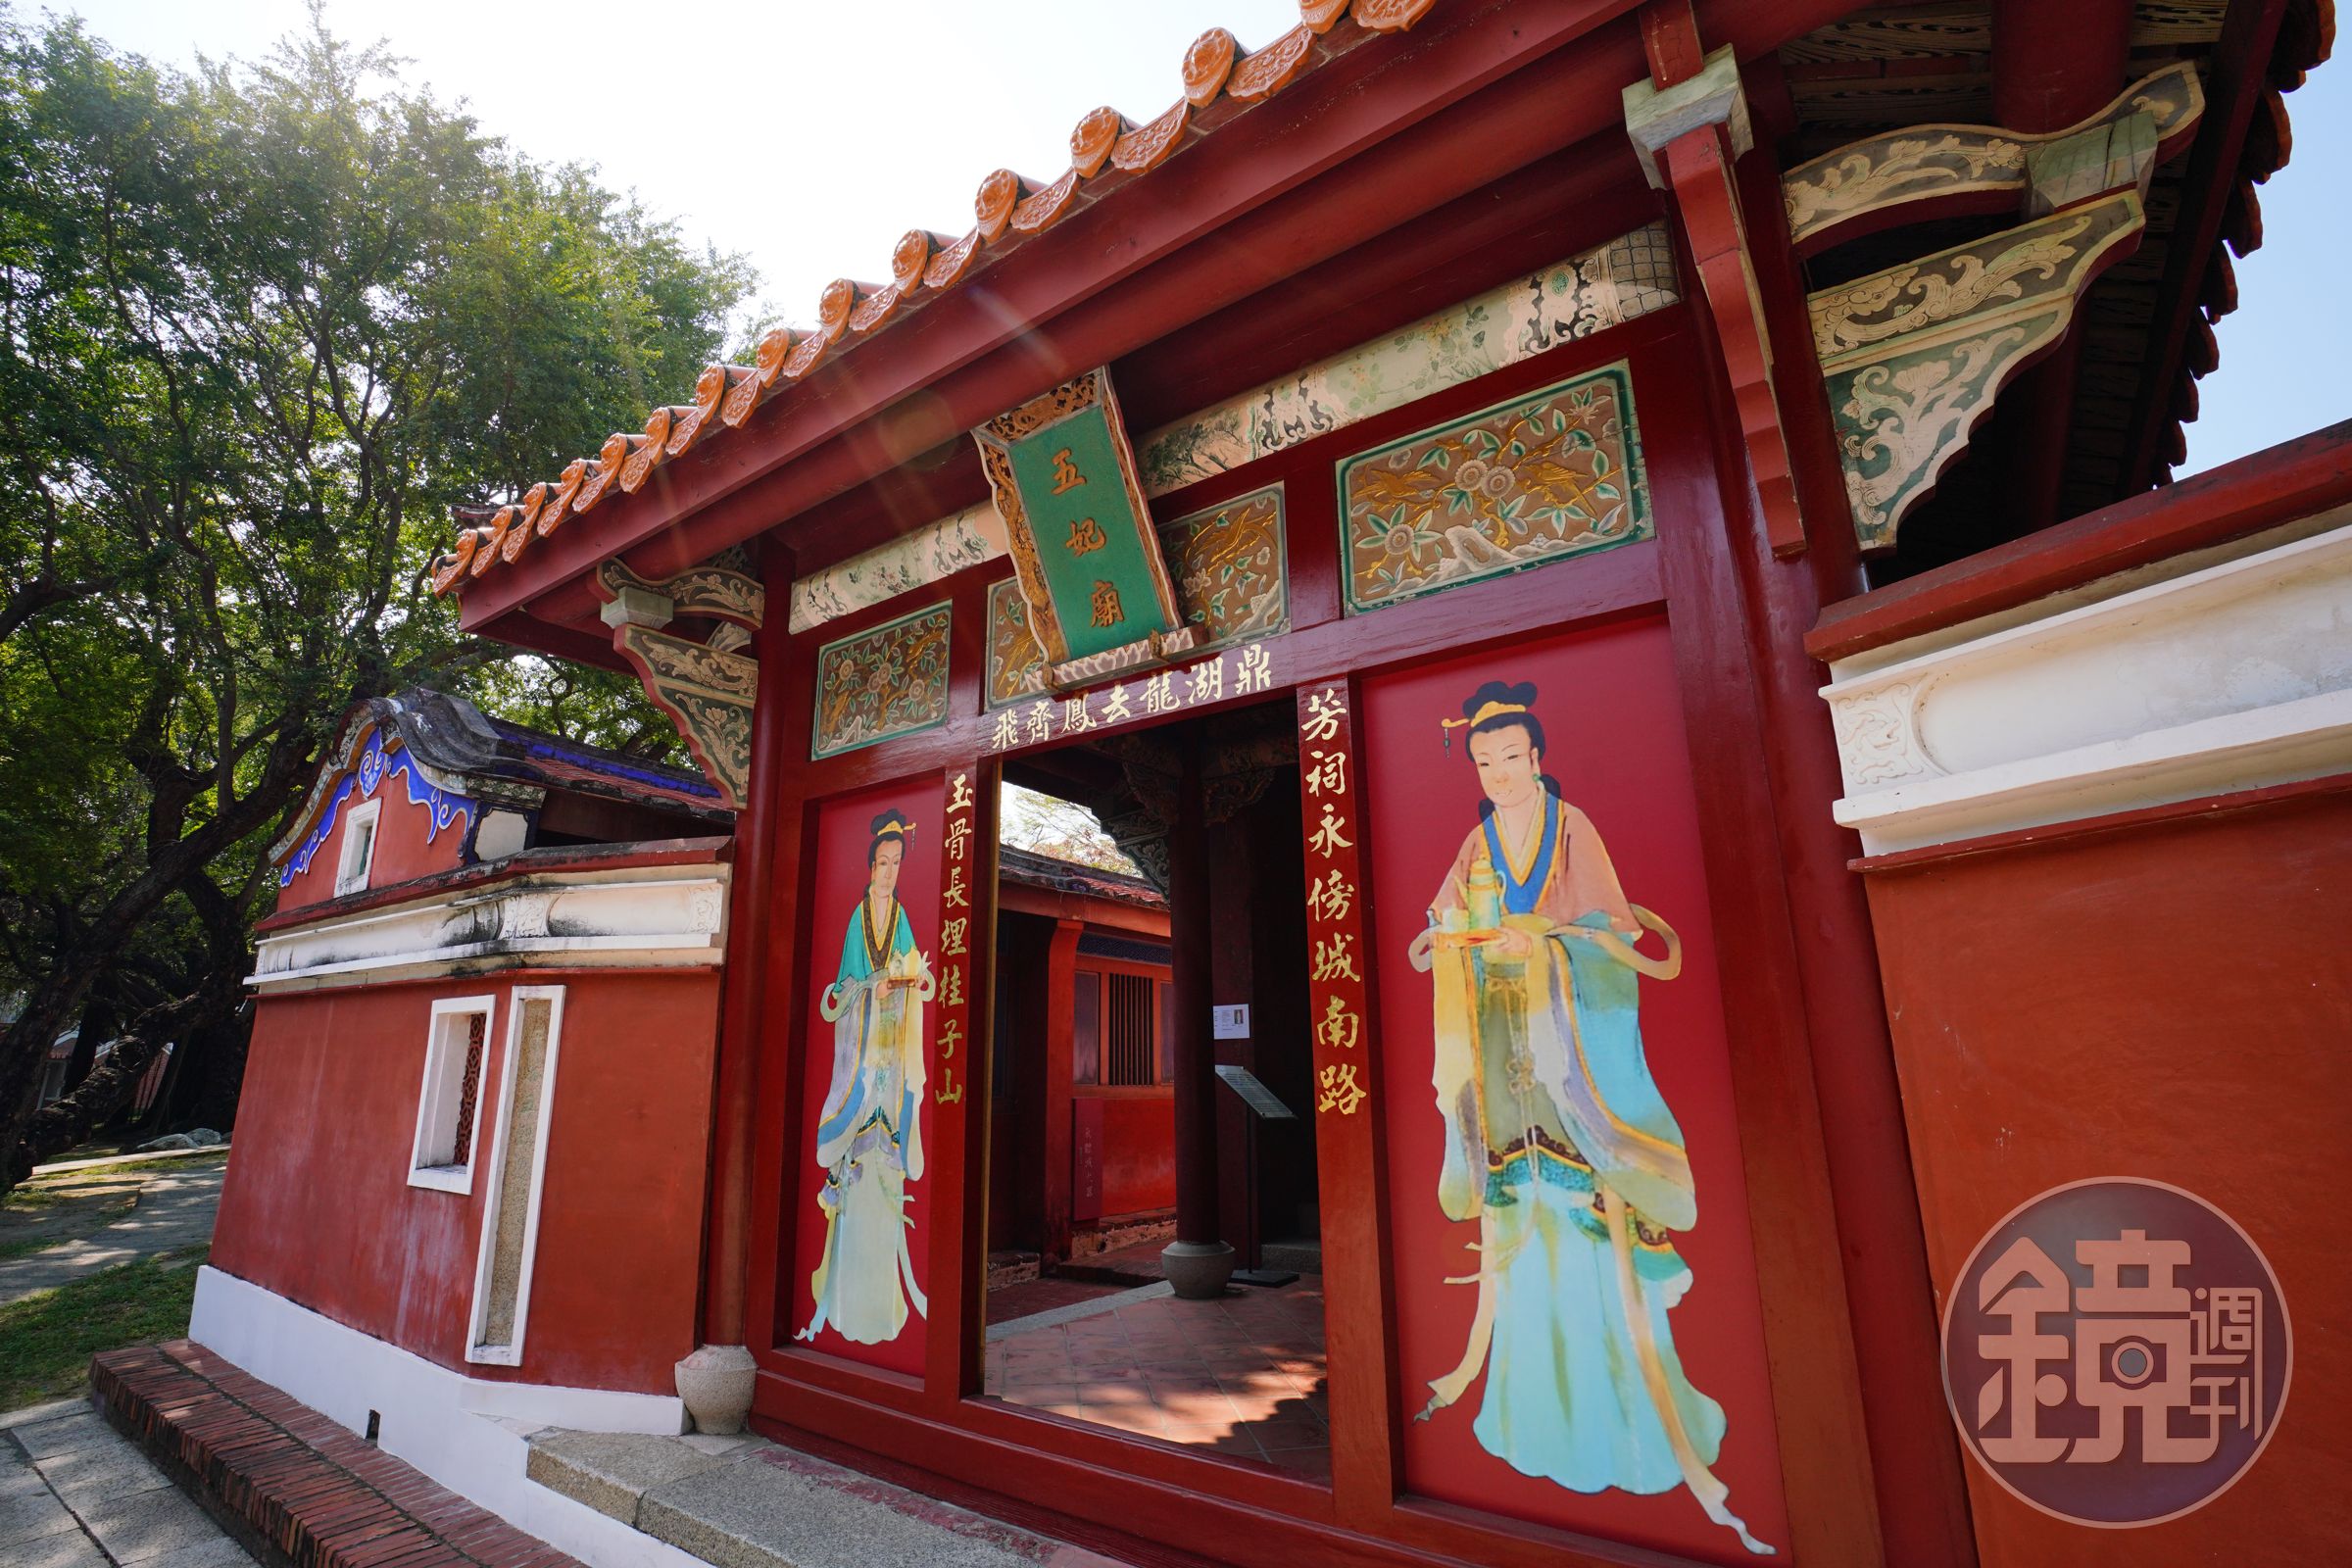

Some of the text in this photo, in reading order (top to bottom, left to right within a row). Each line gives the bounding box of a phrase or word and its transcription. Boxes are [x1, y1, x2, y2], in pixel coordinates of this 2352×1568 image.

[1051, 448, 1125, 628] 五妃廟
[1300, 689, 1367, 1115] 芳祠永傍城南路
